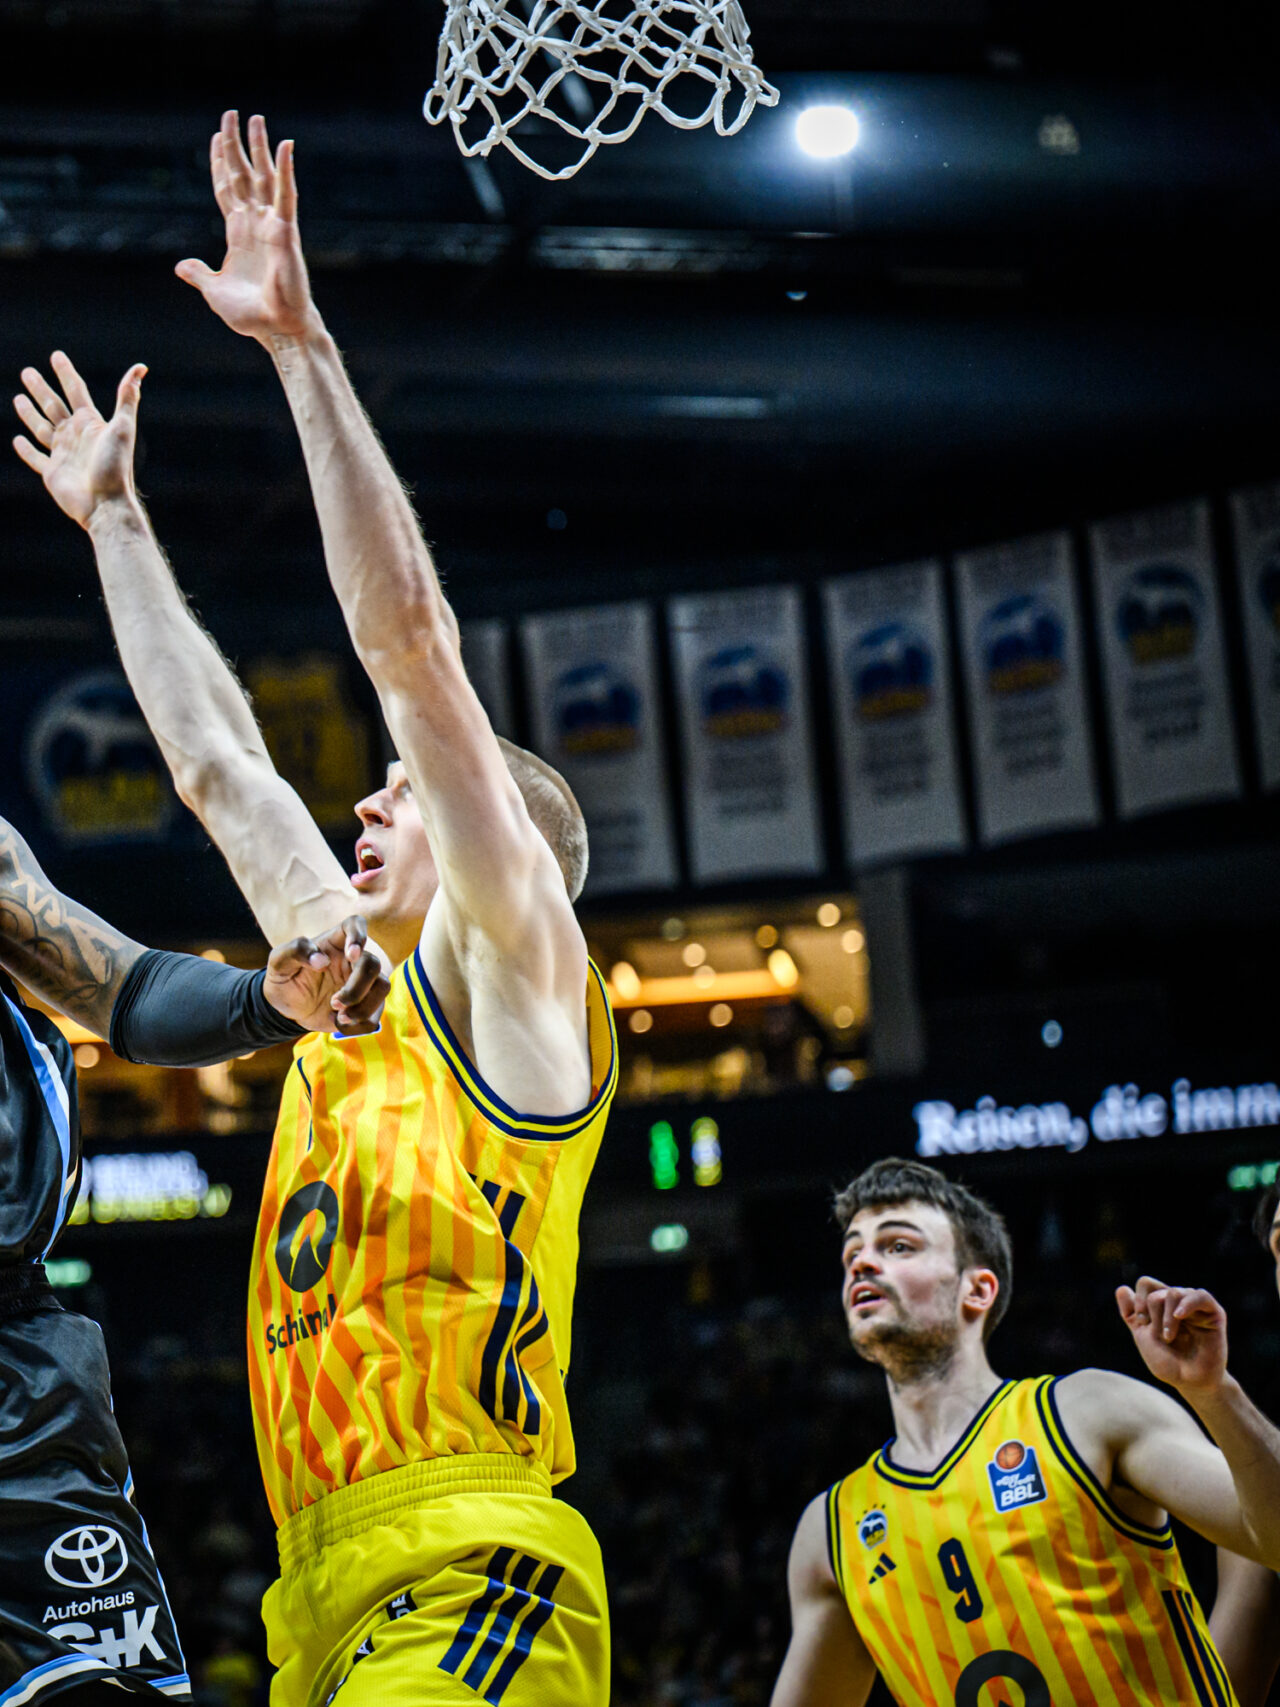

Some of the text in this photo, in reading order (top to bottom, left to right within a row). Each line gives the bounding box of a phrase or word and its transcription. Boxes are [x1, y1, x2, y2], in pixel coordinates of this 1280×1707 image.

[913, 1097, 1089, 1158] Reisen,
[1091, 1082, 1168, 1142] die
[1000, 1483, 1040, 1507] BBL
[42, 1590, 136, 1624] Autohaus
[938, 1537, 984, 1624] 9
